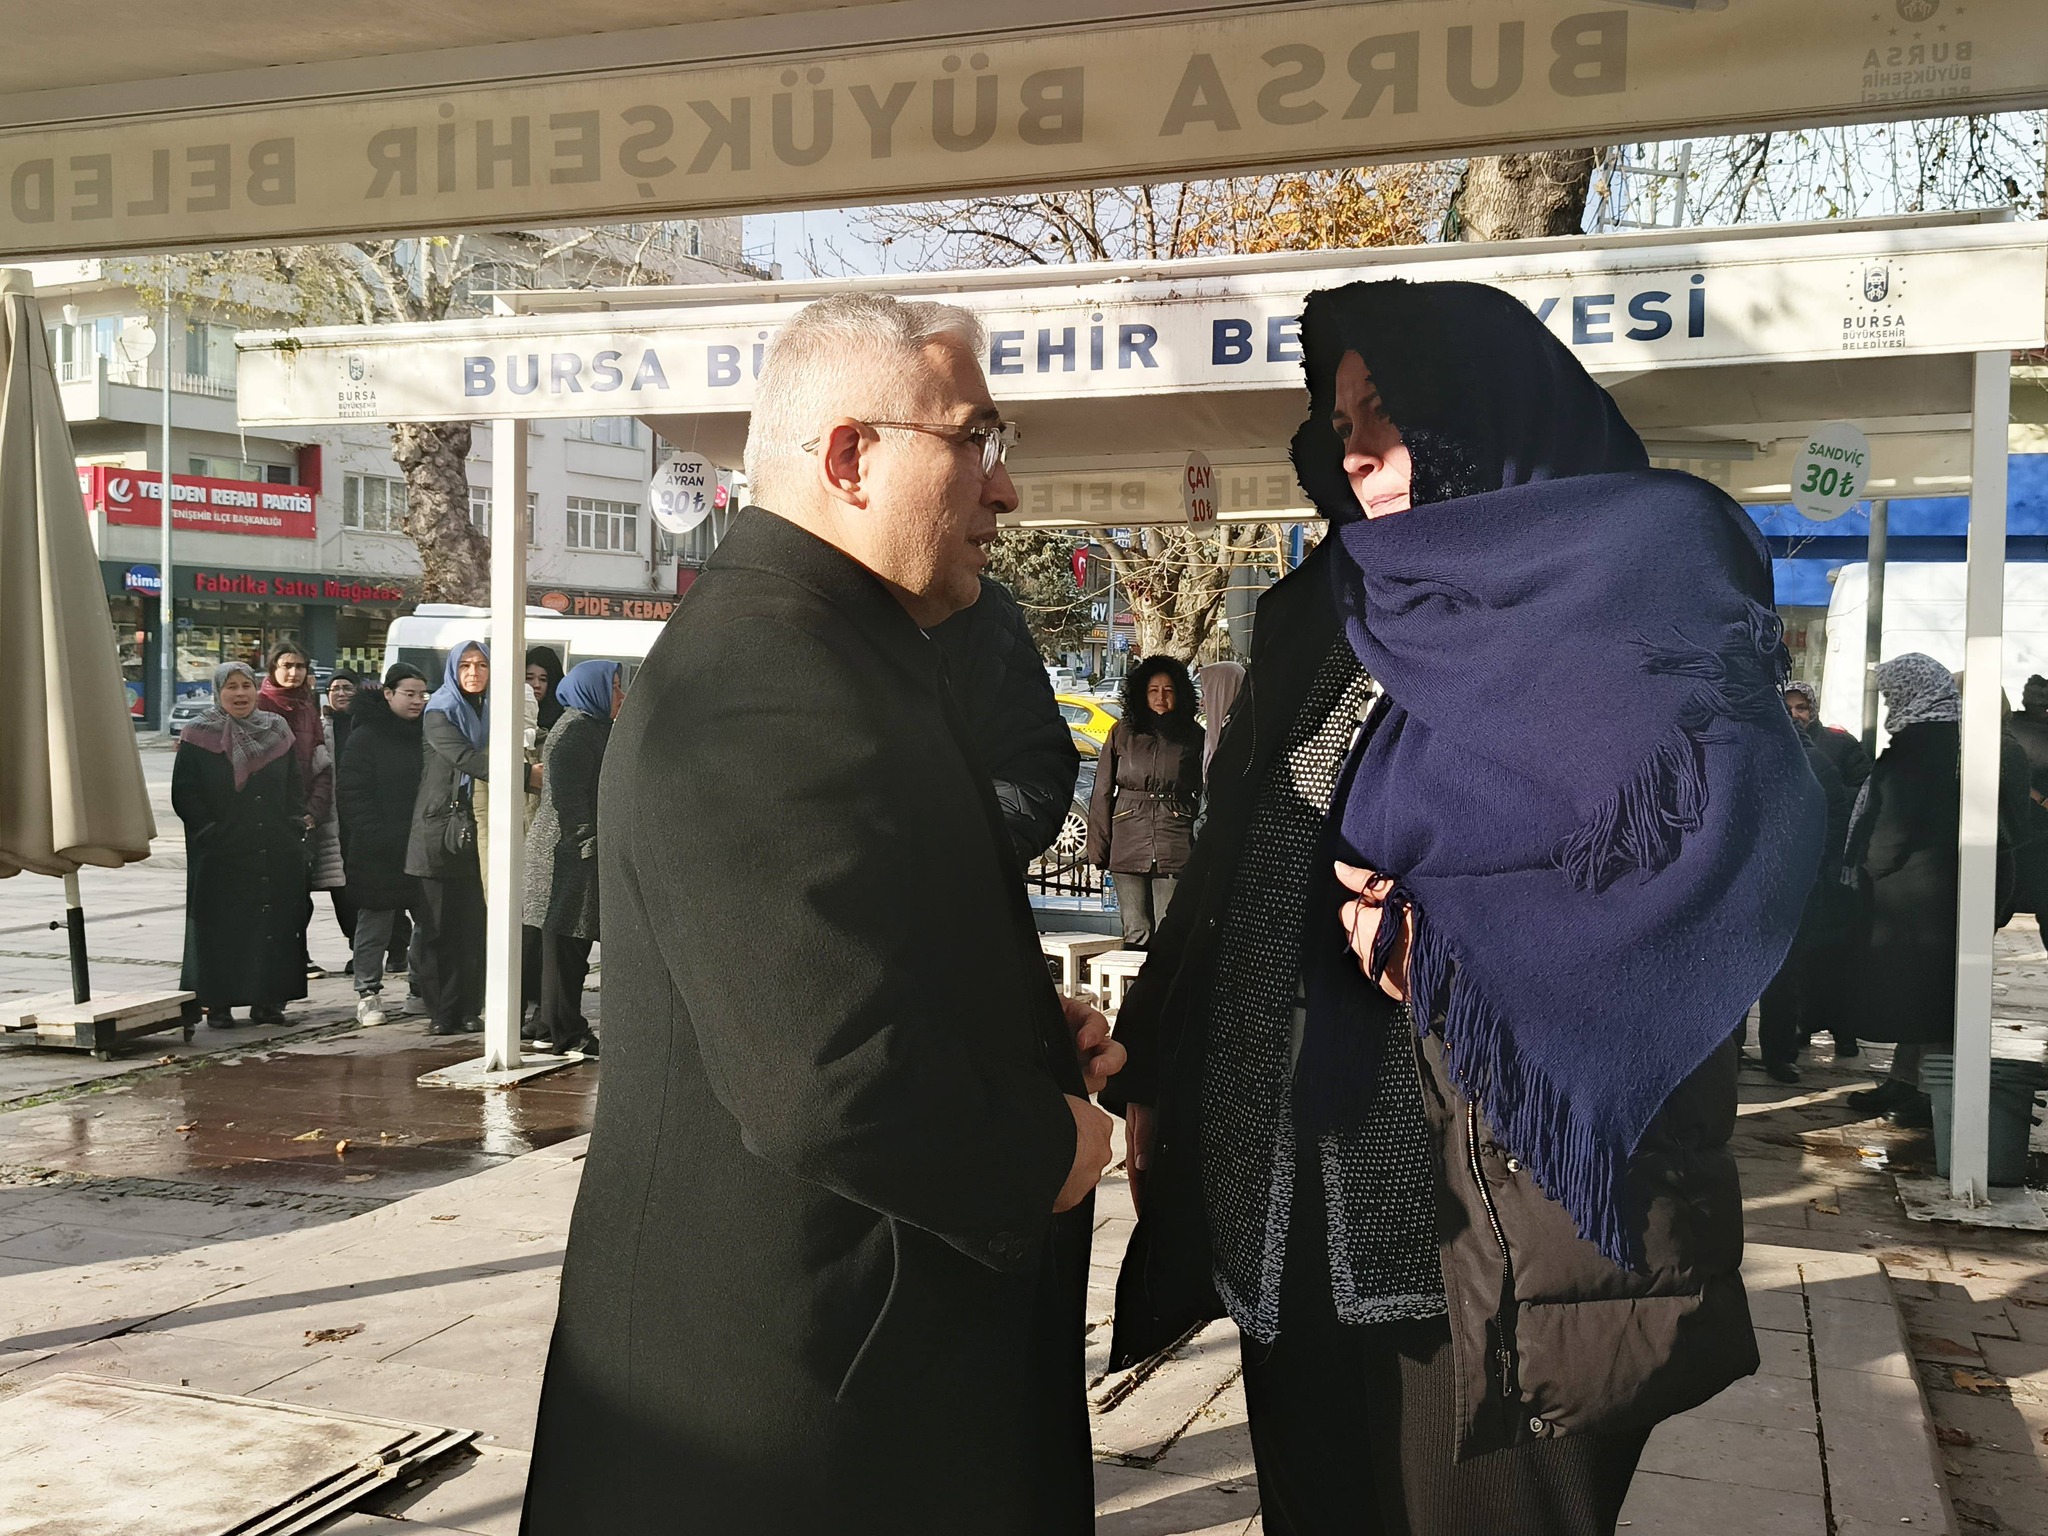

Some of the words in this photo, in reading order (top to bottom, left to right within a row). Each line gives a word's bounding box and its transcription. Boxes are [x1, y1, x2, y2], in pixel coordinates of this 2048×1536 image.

[1843, 315, 1905, 329] BURSA
[1842, 338, 1906, 350] BELEDİYESİ
[464, 348, 670, 397] BURSA
[338, 390, 377, 401] BURSA
[673, 462, 703, 474] TOST
[1807, 442, 1865, 469] SANDVİÇ
[665, 475, 705, 487] AYRAN
[1187, 466, 1211, 494] ÇAY
[210, 487, 258, 508] REFAH
[262, 492, 312, 513] PARTİSİ
[195, 573, 268, 596] Fabrika
[275, 576, 319, 598] Satış
[574, 591, 610, 617] PİDE
[622, 600, 673, 620] KEBAP
